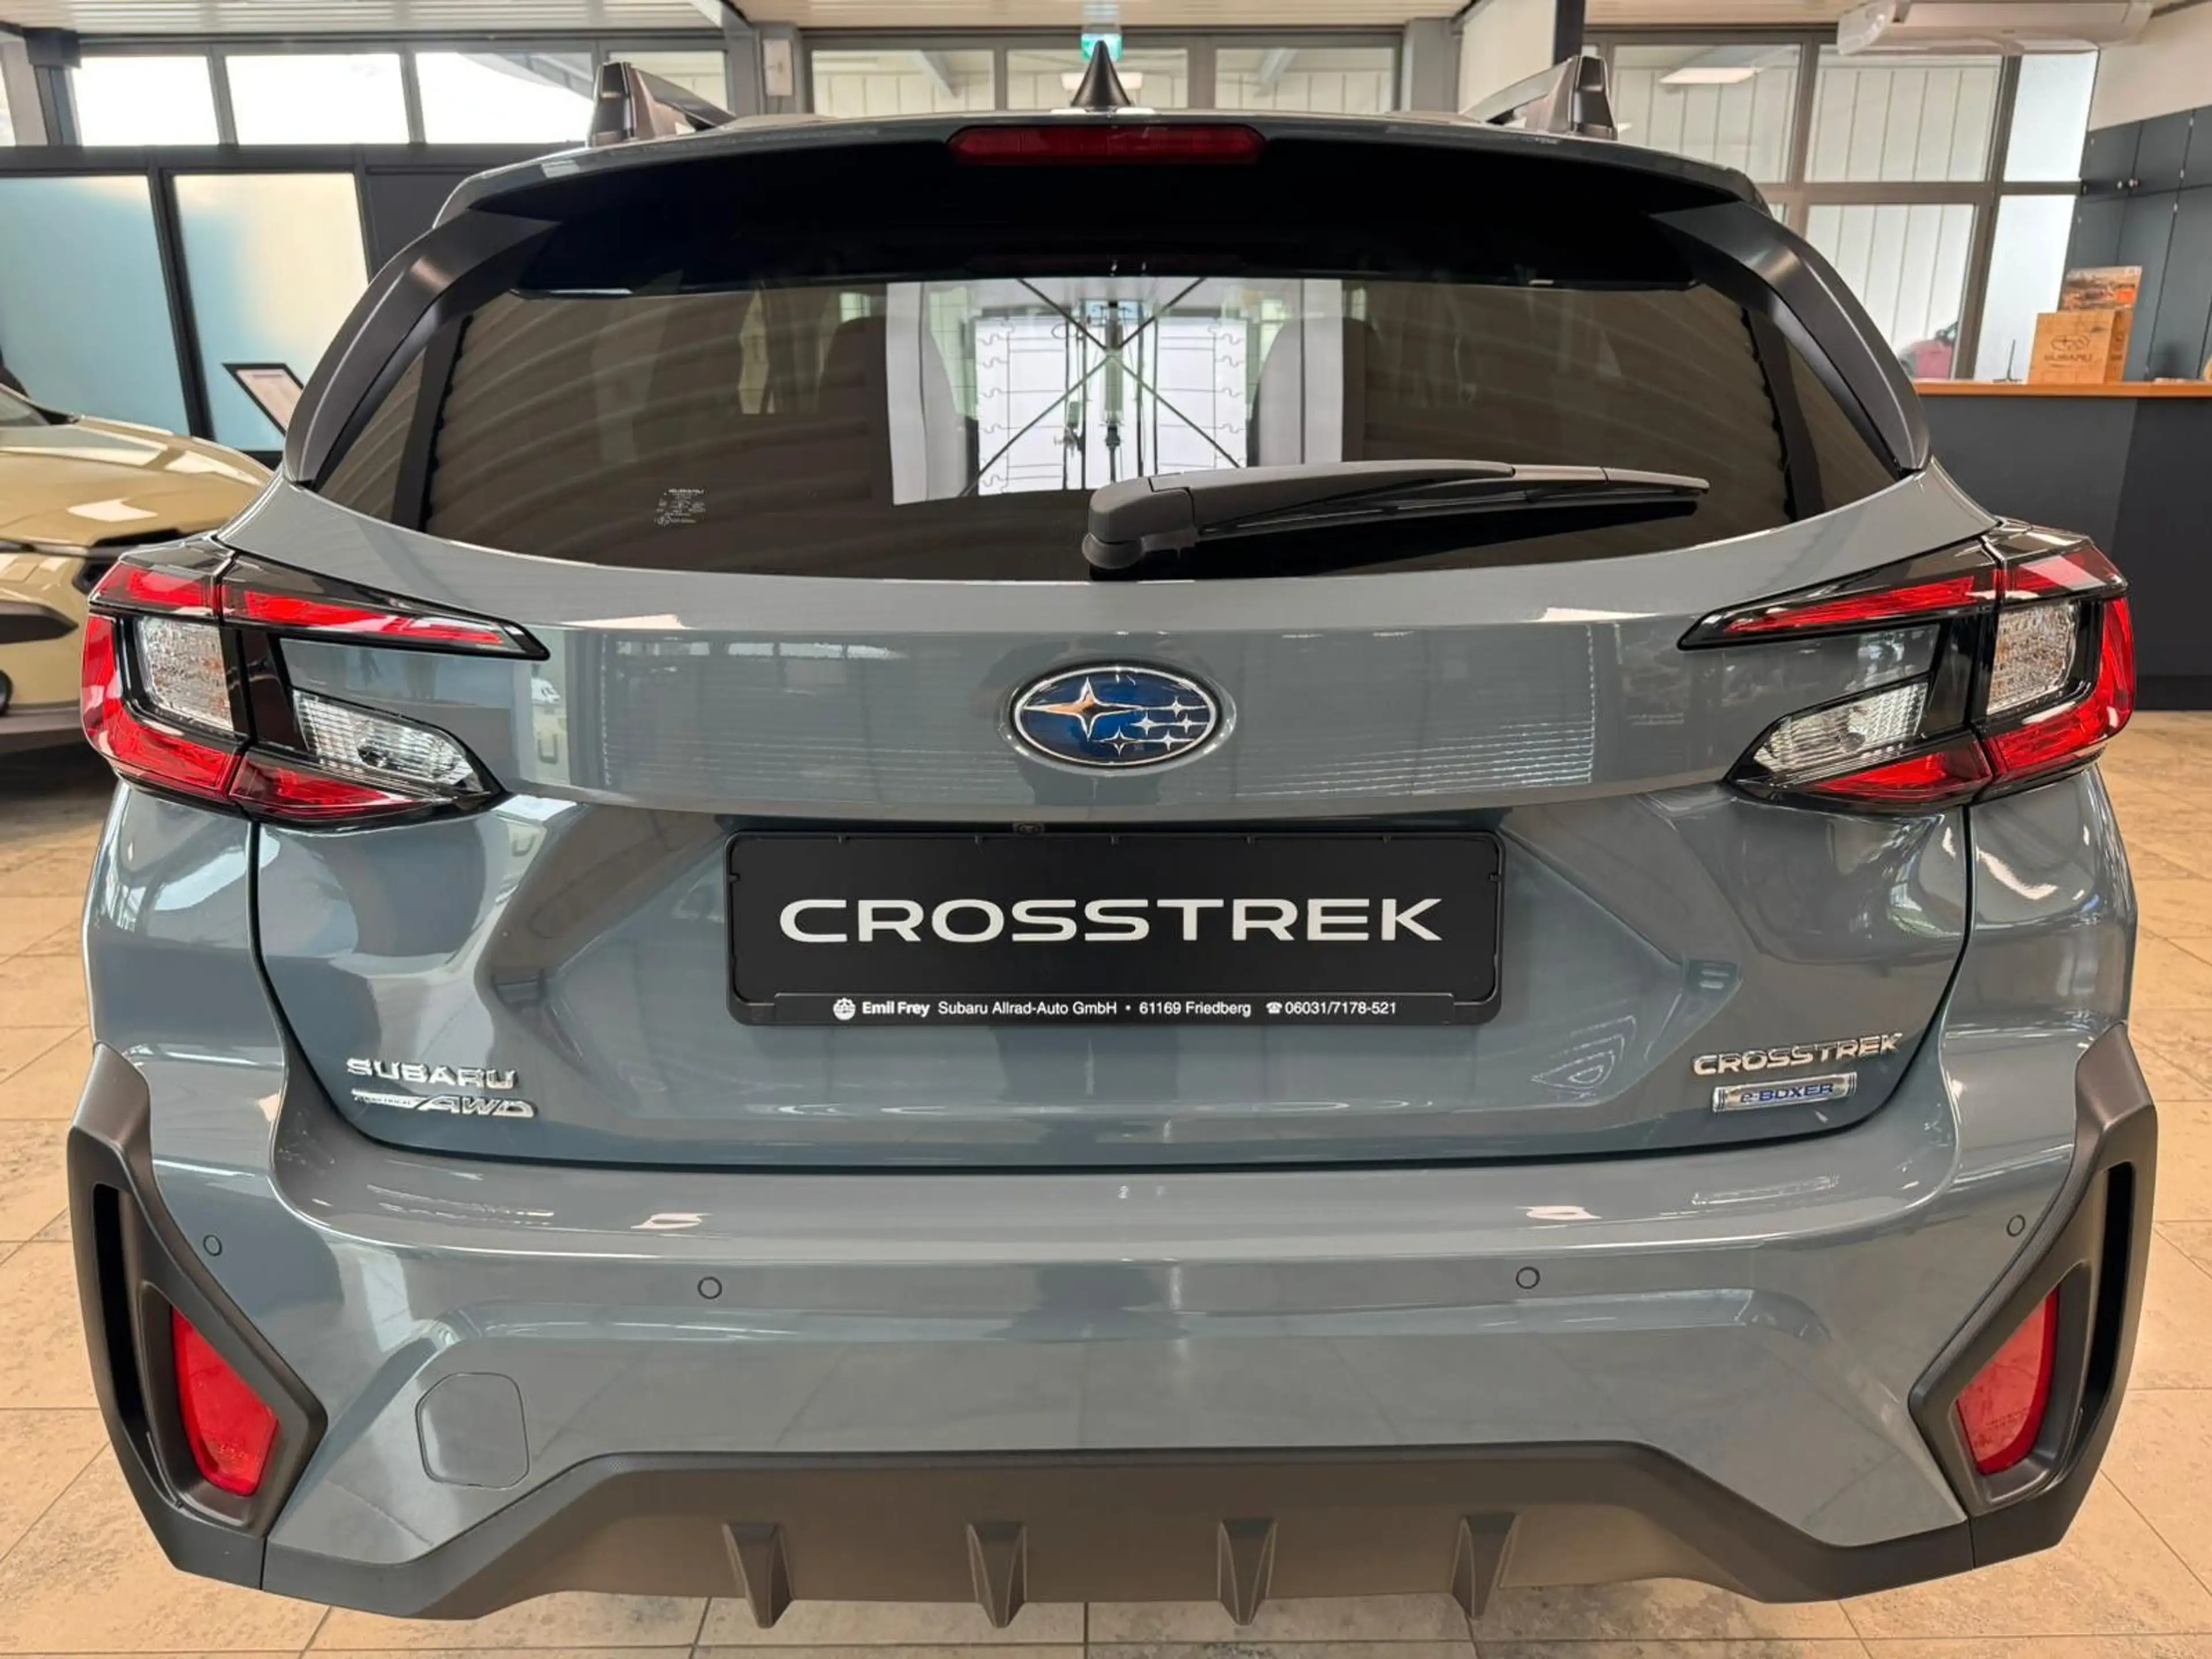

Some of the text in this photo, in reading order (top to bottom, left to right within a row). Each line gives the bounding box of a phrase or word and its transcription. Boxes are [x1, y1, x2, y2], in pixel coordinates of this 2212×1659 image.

[779, 899, 1442, 943] CROSSTREK
[862, 1001, 1396, 1018] Emil Frey Subaru Allrad-Auto GmbH 61169 Friedberg 06031/7178-521
[1692, 1032, 1904, 1075] CROSSTREK
[347, 1058, 517, 1089] SUBARU
[418, 1094, 535, 1118] AWD
